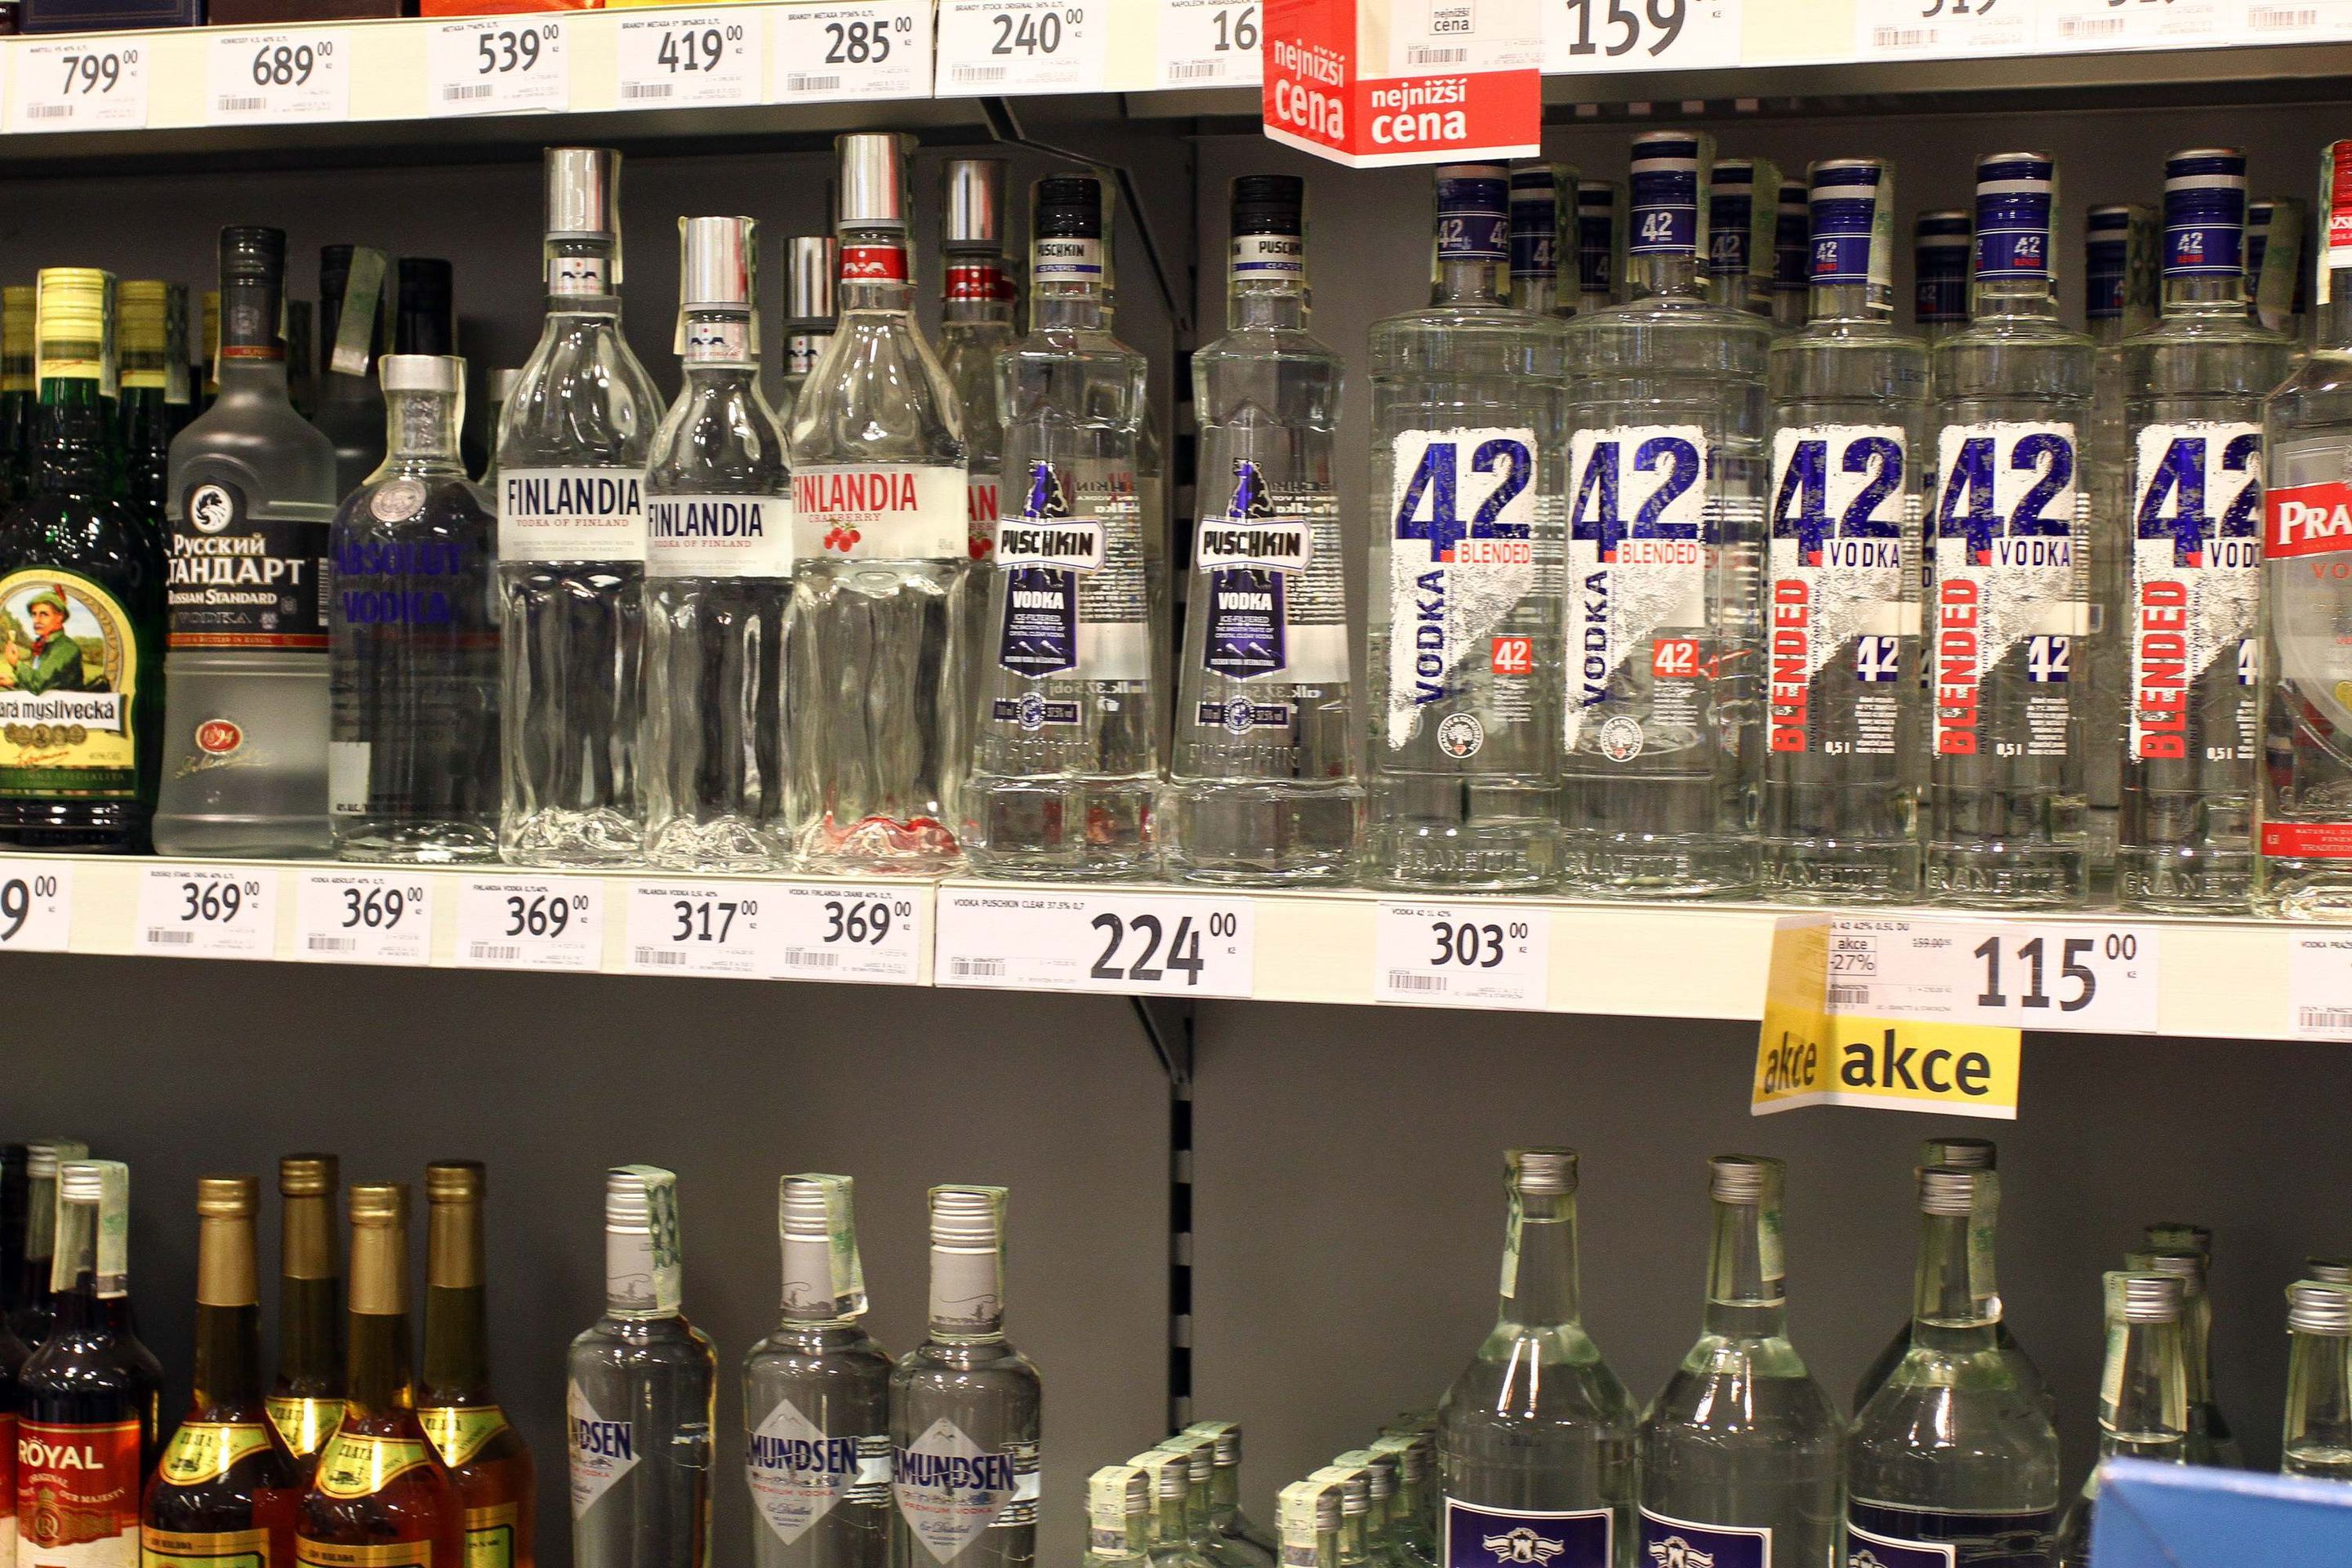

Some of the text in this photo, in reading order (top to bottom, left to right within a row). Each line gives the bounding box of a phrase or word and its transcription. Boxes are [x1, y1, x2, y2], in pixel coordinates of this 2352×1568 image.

[825, 16, 911, 64] 285 00
[992, 8, 1083, 56] 240 00
[1213, 6, 1263, 51] 16
[1434, 19, 1469, 32] cena
[1566, 0, 1686, 56] 159
[253, 41, 332, 86] 689 00
[479, 24, 559, 74] 539 00
[658, 25, 742, 73] 419 00
[1274, 38, 1346, 89] nejnižší
[62, 49, 138, 95] 799 00
[1275, 78, 1346, 140] cena
[1371, 78, 1468, 114] nejnižší
[1371, 110, 1468, 145] cena
[1642, 212, 1673, 243] 42
[2014, 236, 2042, 256] 42
[2176, 232, 2204, 252] 42
[1816, 241, 1838, 261] 42
[508, 478, 642, 516] FINLANDIA
[792, 473, 919, 514] FINLANDIA
[1396, 439, 1532, 564] 42
[1572, 437, 1699, 564] 42
[1773, 436, 1903, 568] 42
[1940, 433, 2073, 567] 42
[2137, 433, 2264, 568] 42
[516, 518, 630, 528] VODKA OF FINLAND
[648, 502, 764, 537] FINLANDIA
[808, 513, 884, 524] CRANBERRY
[2277, 501, 2352, 546] PRA
[684, 540, 697, 548] OF
[701, 539, 752, 549] FINLAND
[1001, 530, 1094, 557] PUSCHKIN
[1204, 531, 1300, 557] PUSCHKIN
[1460, 543, 1531, 564] BLENDED
[1622, 543, 1697, 564] BLENDED
[1830, 542, 1901, 568] VODKA
[2000, 541, 2071, 567] VODKA
[167, 557, 305, 587] ТАНДАРТ
[178, 611, 252, 625] VODKA
[343, 590, 448, 624] VODKA
[1013, 590, 1065, 610] VODKA
[1218, 592, 1273, 611] VODKA
[1415, 569, 1445, 706] VODKA
[1494, 640, 1527, 670] 42
[1583, 570, 1608, 708] VODKA
[1655, 643, 1694, 674] 42
[1772, 579, 1809, 752] BLENDED
[1857, 635, 1899, 683] 42
[1940, 579, 1978, 755] BLENDED
[2029, 635, 2070, 683] 42
[2140, 581, 2187, 759] BLENDED
[23, 699, 114, 720] myslivecká
[35, 875, 56, 898] 00
[180, 881, 260, 924] 369 00
[342, 887, 423, 929] 369 00
[506, 895, 589, 938] 369 00
[673, 900, 758, 943] 317 00
[823, 900, 911, 946] 369 00
[1090, 912, 1236, 986] 224 00
[1430, 921, 1528, 968] 303 00
[1830, 954, 1874, 971] -27%
[1838, 938, 1869, 951] akce
[1973, 933, 2137, 1012] 115 00
[1764, 1031, 1818, 1095] akce
[1841, 1028, 1991, 1096] akce
[18, 1438, 105, 1470] ROYAL
[573, 1417, 633, 1462] DSEN
[746, 1434, 857, 1476] MUNDSEN
